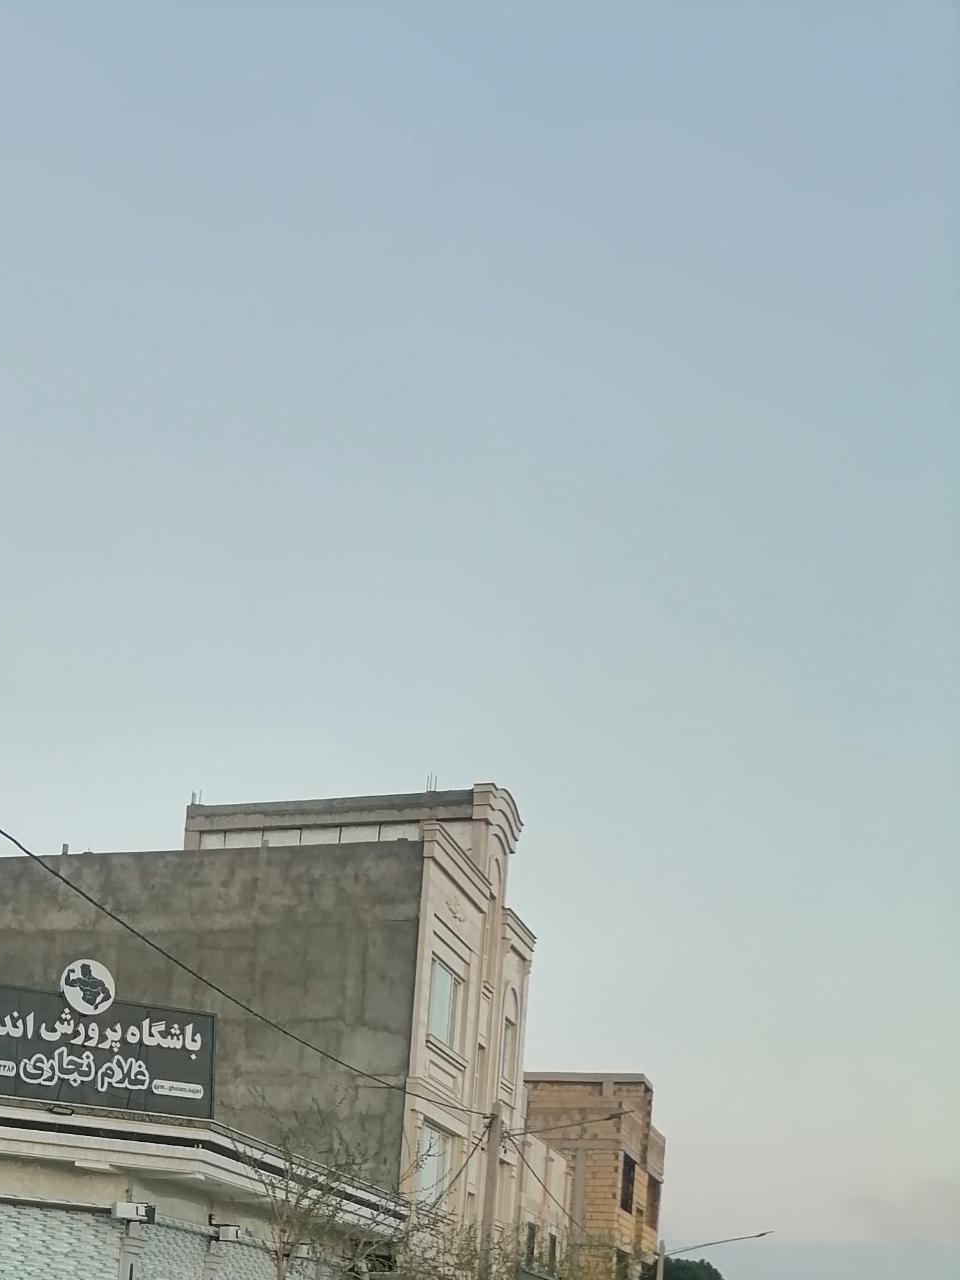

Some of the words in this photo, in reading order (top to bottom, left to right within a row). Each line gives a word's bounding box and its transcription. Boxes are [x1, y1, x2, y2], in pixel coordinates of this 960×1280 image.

[40, 1007, 122, 1053] پرورش
[126, 1017, 203, 1060] باشگاه
[19, 1046, 96, 1087] نجاری
[97, 1055, 150, 1092] غلام
